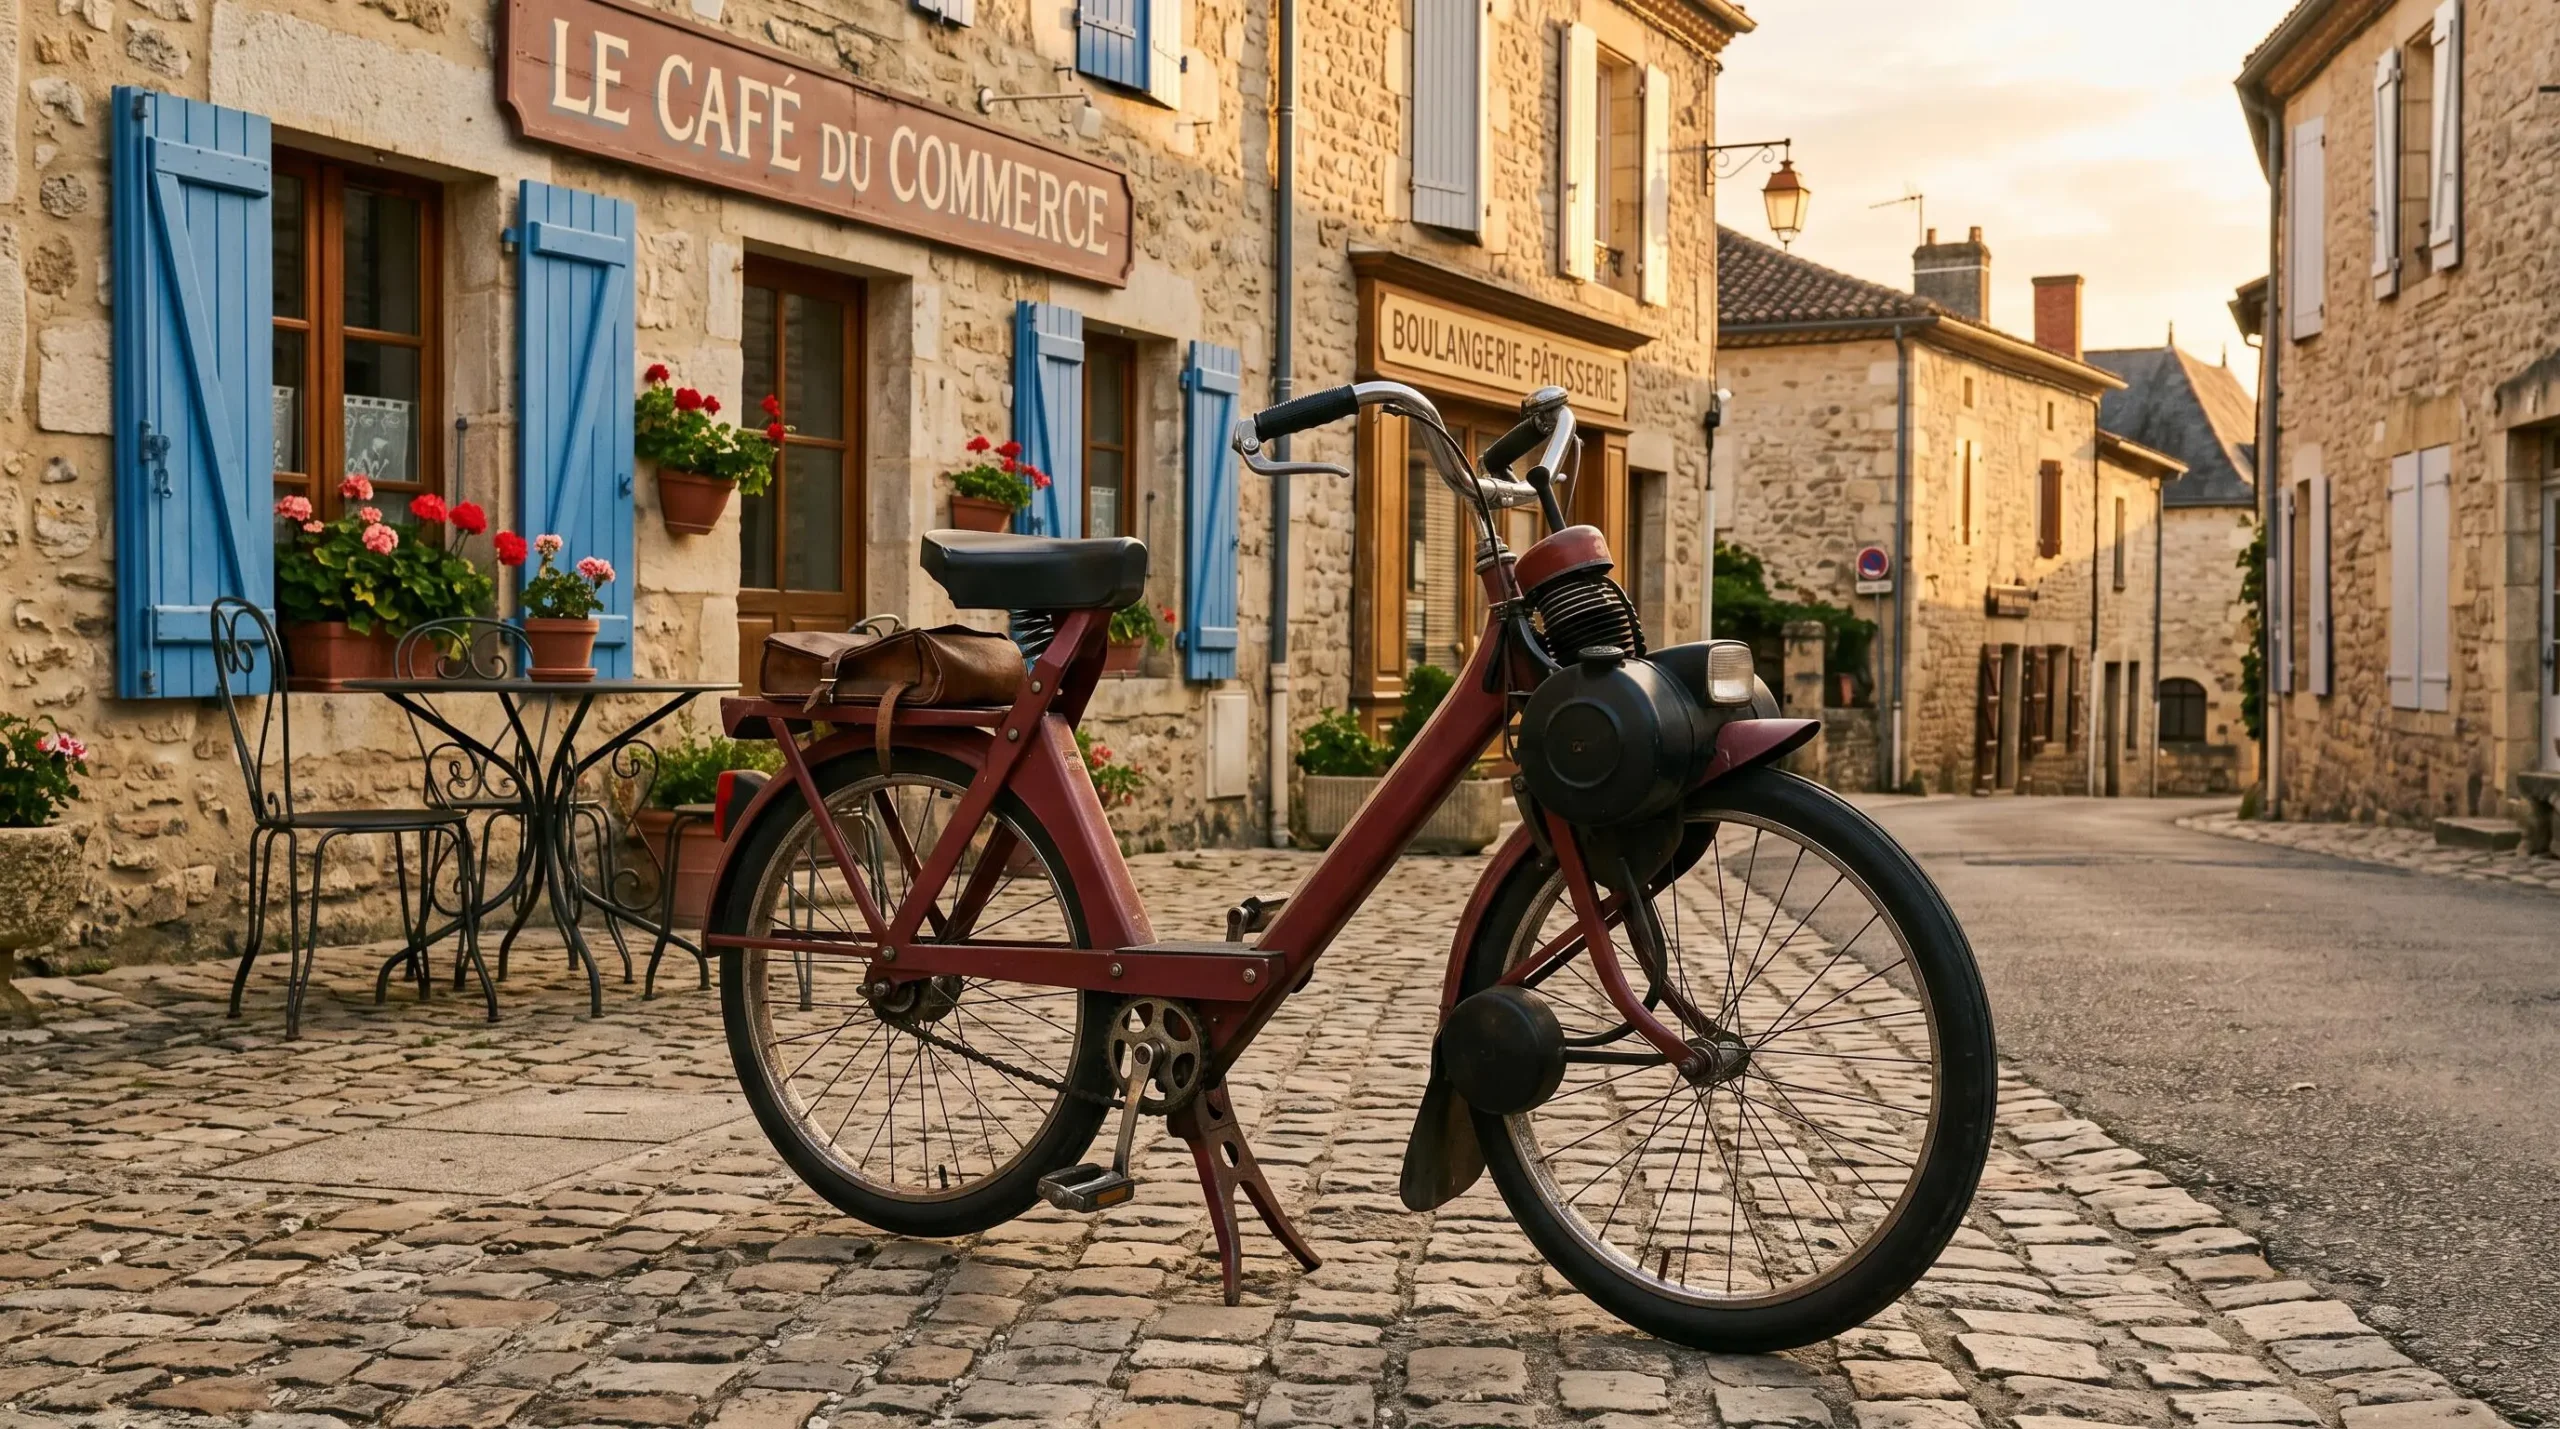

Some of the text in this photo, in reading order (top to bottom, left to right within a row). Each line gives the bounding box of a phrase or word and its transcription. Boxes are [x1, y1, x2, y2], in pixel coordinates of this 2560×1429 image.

[552, 19, 1109, 256] LE CAFÉ DU COMMERCE
[1393, 310, 1618, 403] BOULANGERIE-PÂTISSERIE
